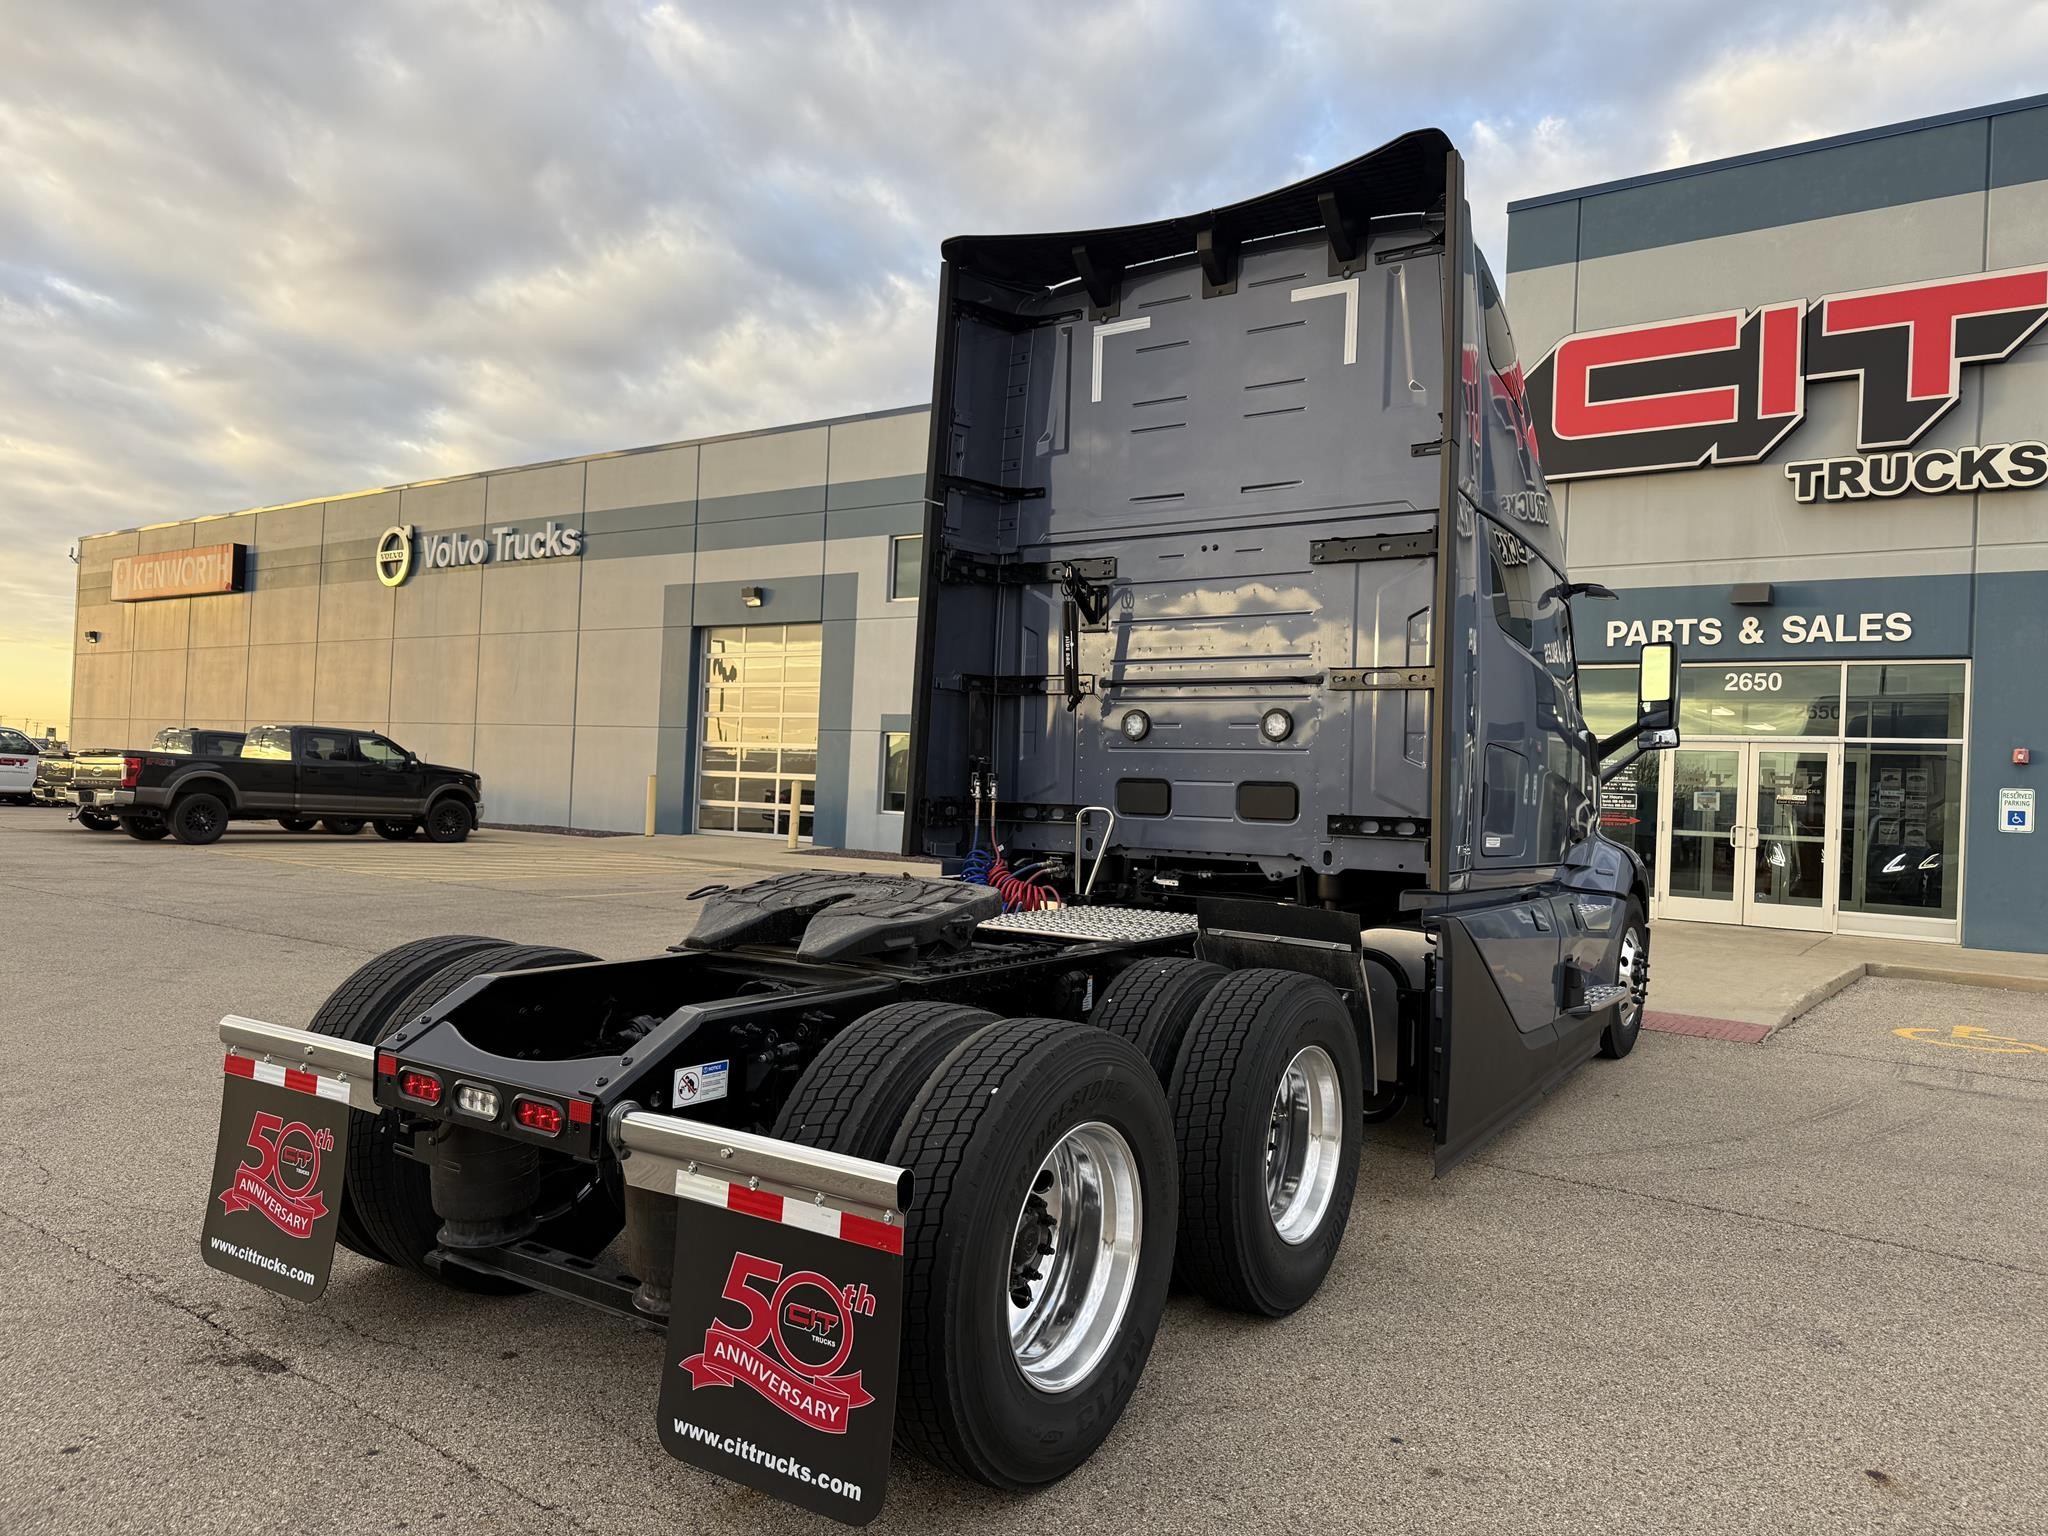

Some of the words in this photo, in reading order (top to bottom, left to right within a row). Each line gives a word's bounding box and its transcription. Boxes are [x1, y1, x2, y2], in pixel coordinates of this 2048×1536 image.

[1540, 264, 2048, 464] CIT
[1787, 442, 2048, 502] TRUCKS
[380, 550, 404, 562] VOLVO
[423, 533, 486, 568] Volvo
[493, 521, 580, 561] Trucks
[132, 551, 230, 591] KENWORTH
[1606, 617, 1722, 647] PARTS
[1738, 616, 1765, 644] &
[1781, 612, 1912, 643] SALES
[1724, 672, 1783, 692] 2650
[2002, 791, 2033, 800] RESERVED
[2003, 799, 2031, 807] PARKING
[281, 1146, 313, 1168] CIT
[295, 1167, 310, 1176] TRUCKS
[239, 1178, 309, 1231] ANNIVERSARY
[210, 1236, 316, 1286] www.cittrucks.com
[784, 1302, 839, 1336] CIT
[811, 1334, 836, 1348] TRUCKS
[713, 1340, 840, 1423] ANNIVERSARY
[673, 1417, 862, 1502] www.cittrucks.com
